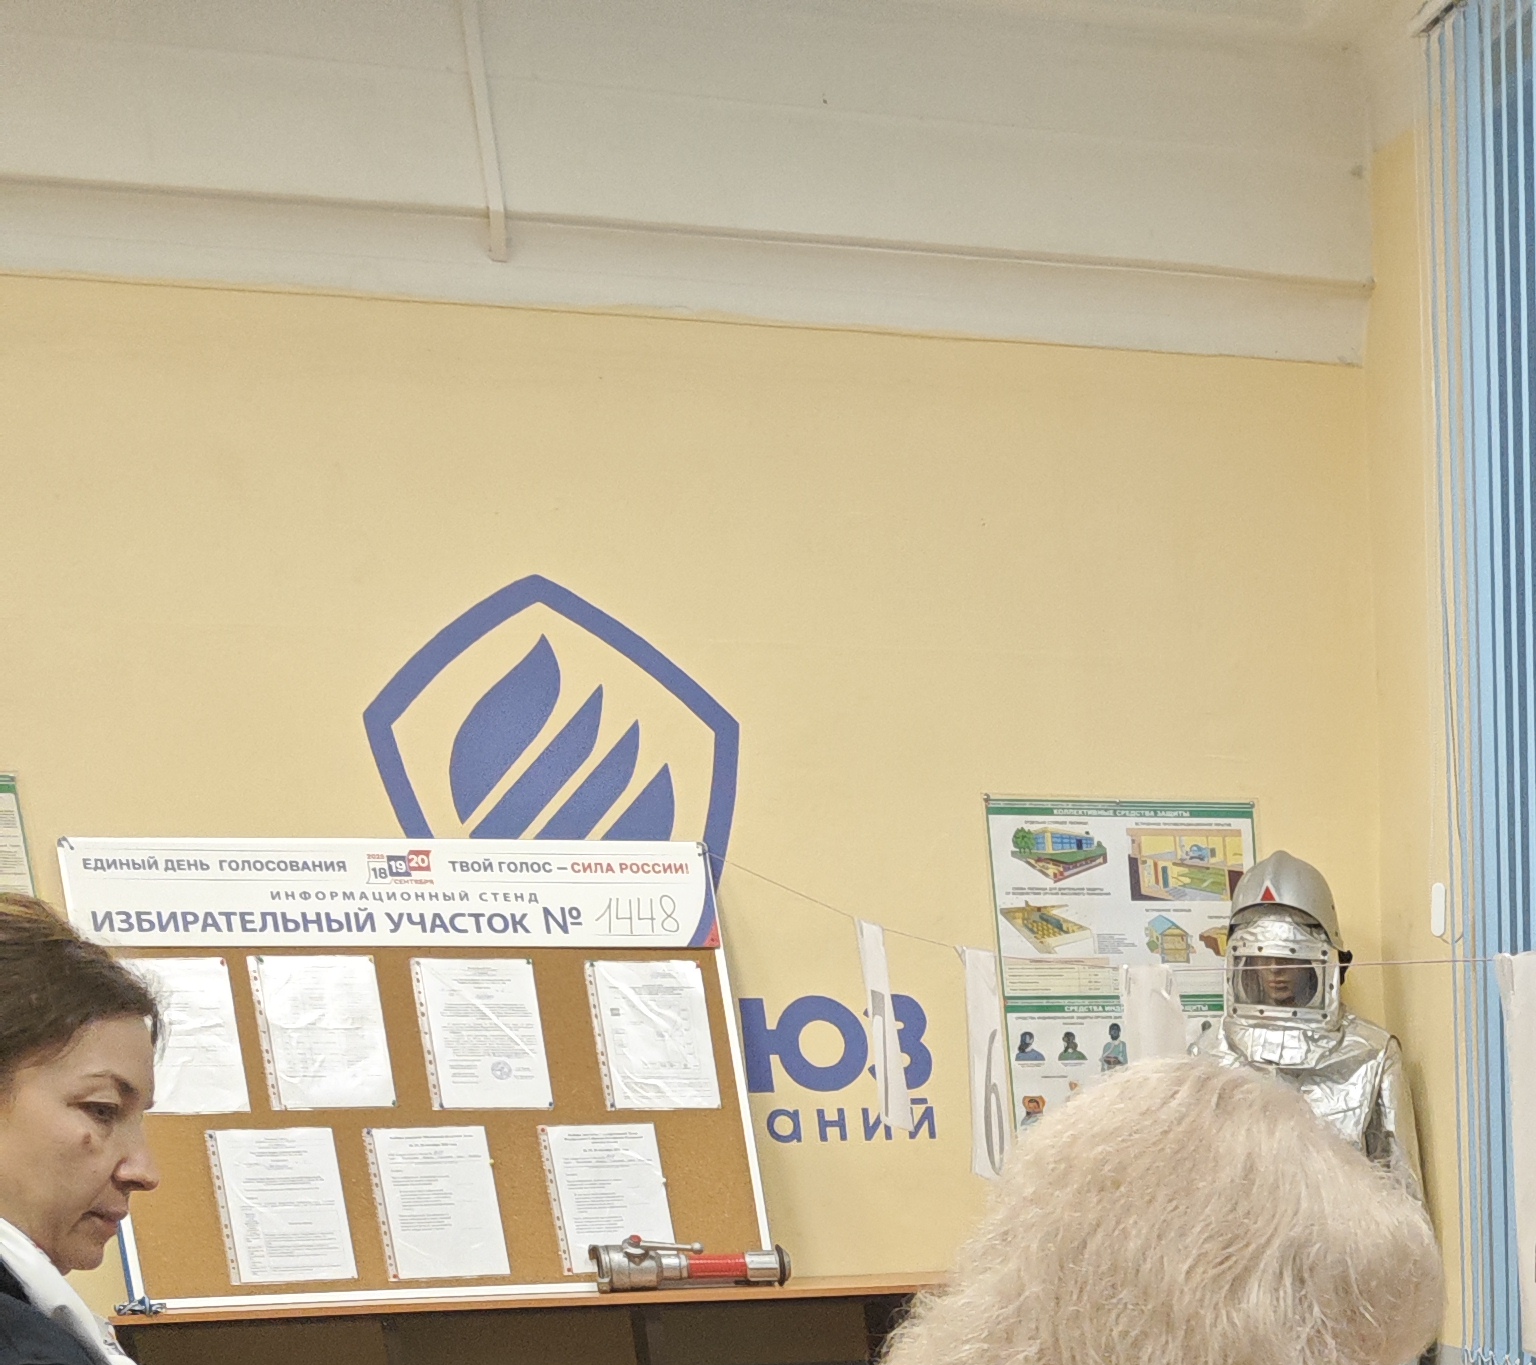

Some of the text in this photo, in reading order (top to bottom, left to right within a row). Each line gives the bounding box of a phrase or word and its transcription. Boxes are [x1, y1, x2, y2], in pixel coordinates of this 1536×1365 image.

[82, 856, 347, 873] ЕДИНЫЙ ДЕНЬ ГОЛОСОВАНИЯ
[371, 854, 429, 879] 18 19 20
[448, 858, 494, 873] ТВОЙ
[498, 861, 552, 874] ГОЛОС
[571, 862, 616, 874] СИЛА
[618, 862, 690, 875] РОССИИ!
[270, 890, 540, 904] ИНФОРМАЦИОННЫЙ СТЕНД
[90, 906, 583, 934] ИЗБИРАТЕЛЬНЫЙ УЧАСТОК №
[595, 894, 680, 935] 1448
